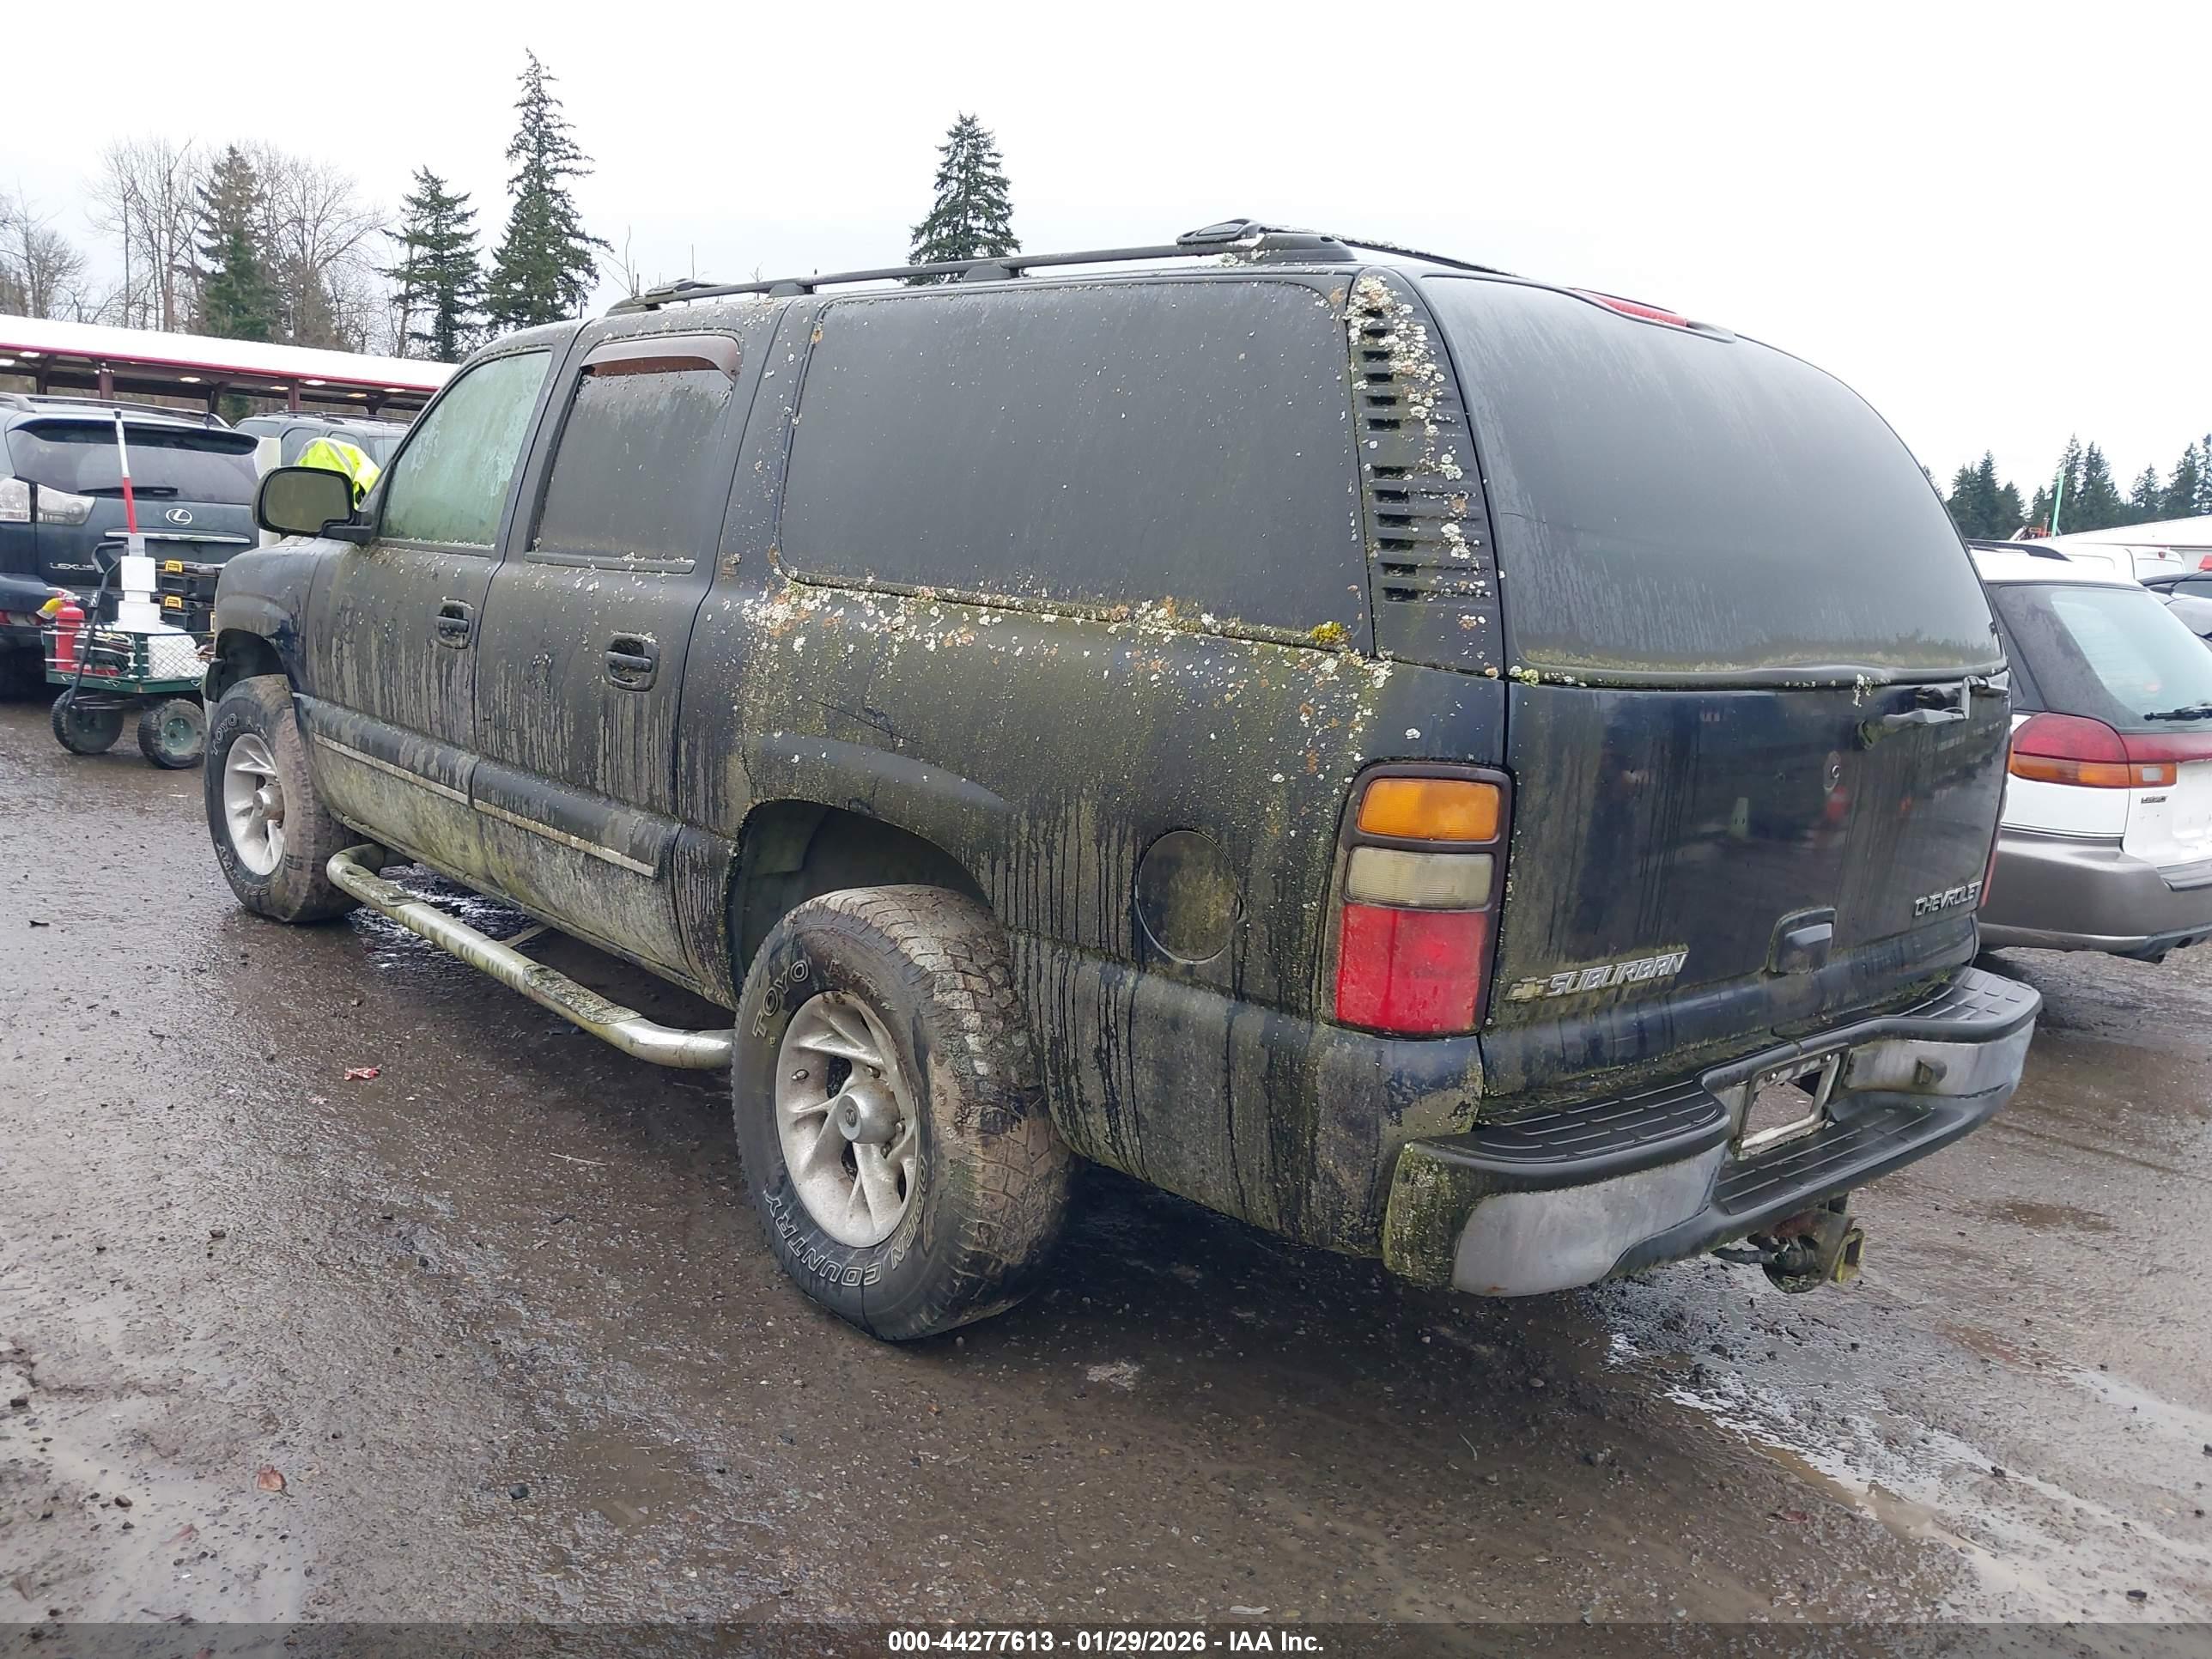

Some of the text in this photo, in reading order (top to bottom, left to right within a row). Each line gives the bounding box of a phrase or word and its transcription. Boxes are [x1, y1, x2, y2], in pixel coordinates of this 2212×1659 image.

[49, 562, 96, 571] LEXUS
[1914, 879, 1984, 917] CHEVROLET
[1546, 950, 1691, 998] SUBURBAN
[751, 959, 810, 1038] TOYO
[763, 1153, 928, 1287] OPEN COUNTRY
